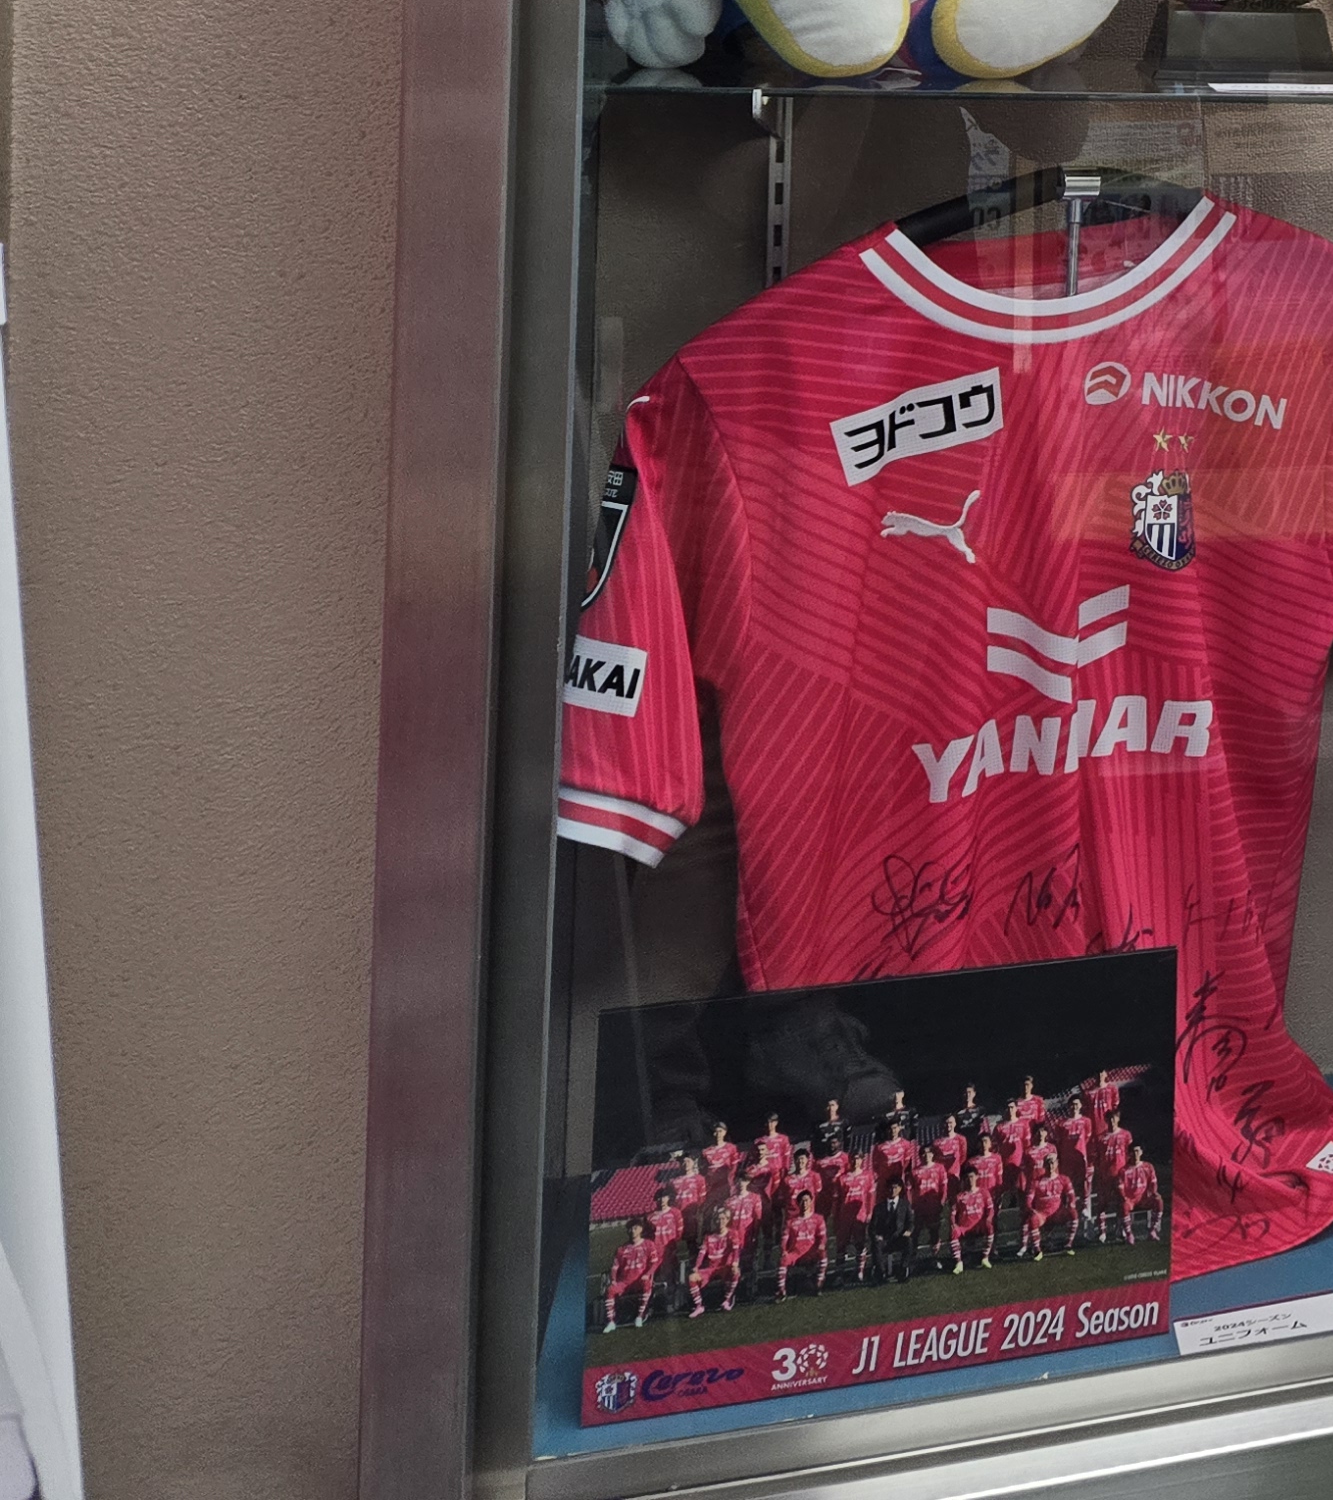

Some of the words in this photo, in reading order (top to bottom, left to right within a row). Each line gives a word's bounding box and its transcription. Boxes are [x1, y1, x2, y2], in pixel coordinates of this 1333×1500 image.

[1141, 371, 1288, 430] NIKKON
[844, 384, 997, 469] ヨドコウ
[566, 654, 642, 699] AKAI
[852, 1334, 881, 1376] J1
[893, 1317, 993, 1368] LEAGUE
[1000, 1304, 1067, 1352] 2024
[1074, 1299, 1160, 1339] Season
[1199, 1319, 1309, 1348] ユニフォーム
[1213, 1312, 1293, 1333] 2024シーズン
[640, 1366, 745, 1402] Cerezo
[770, 1376, 829, 1392] ANNIVERSARY
